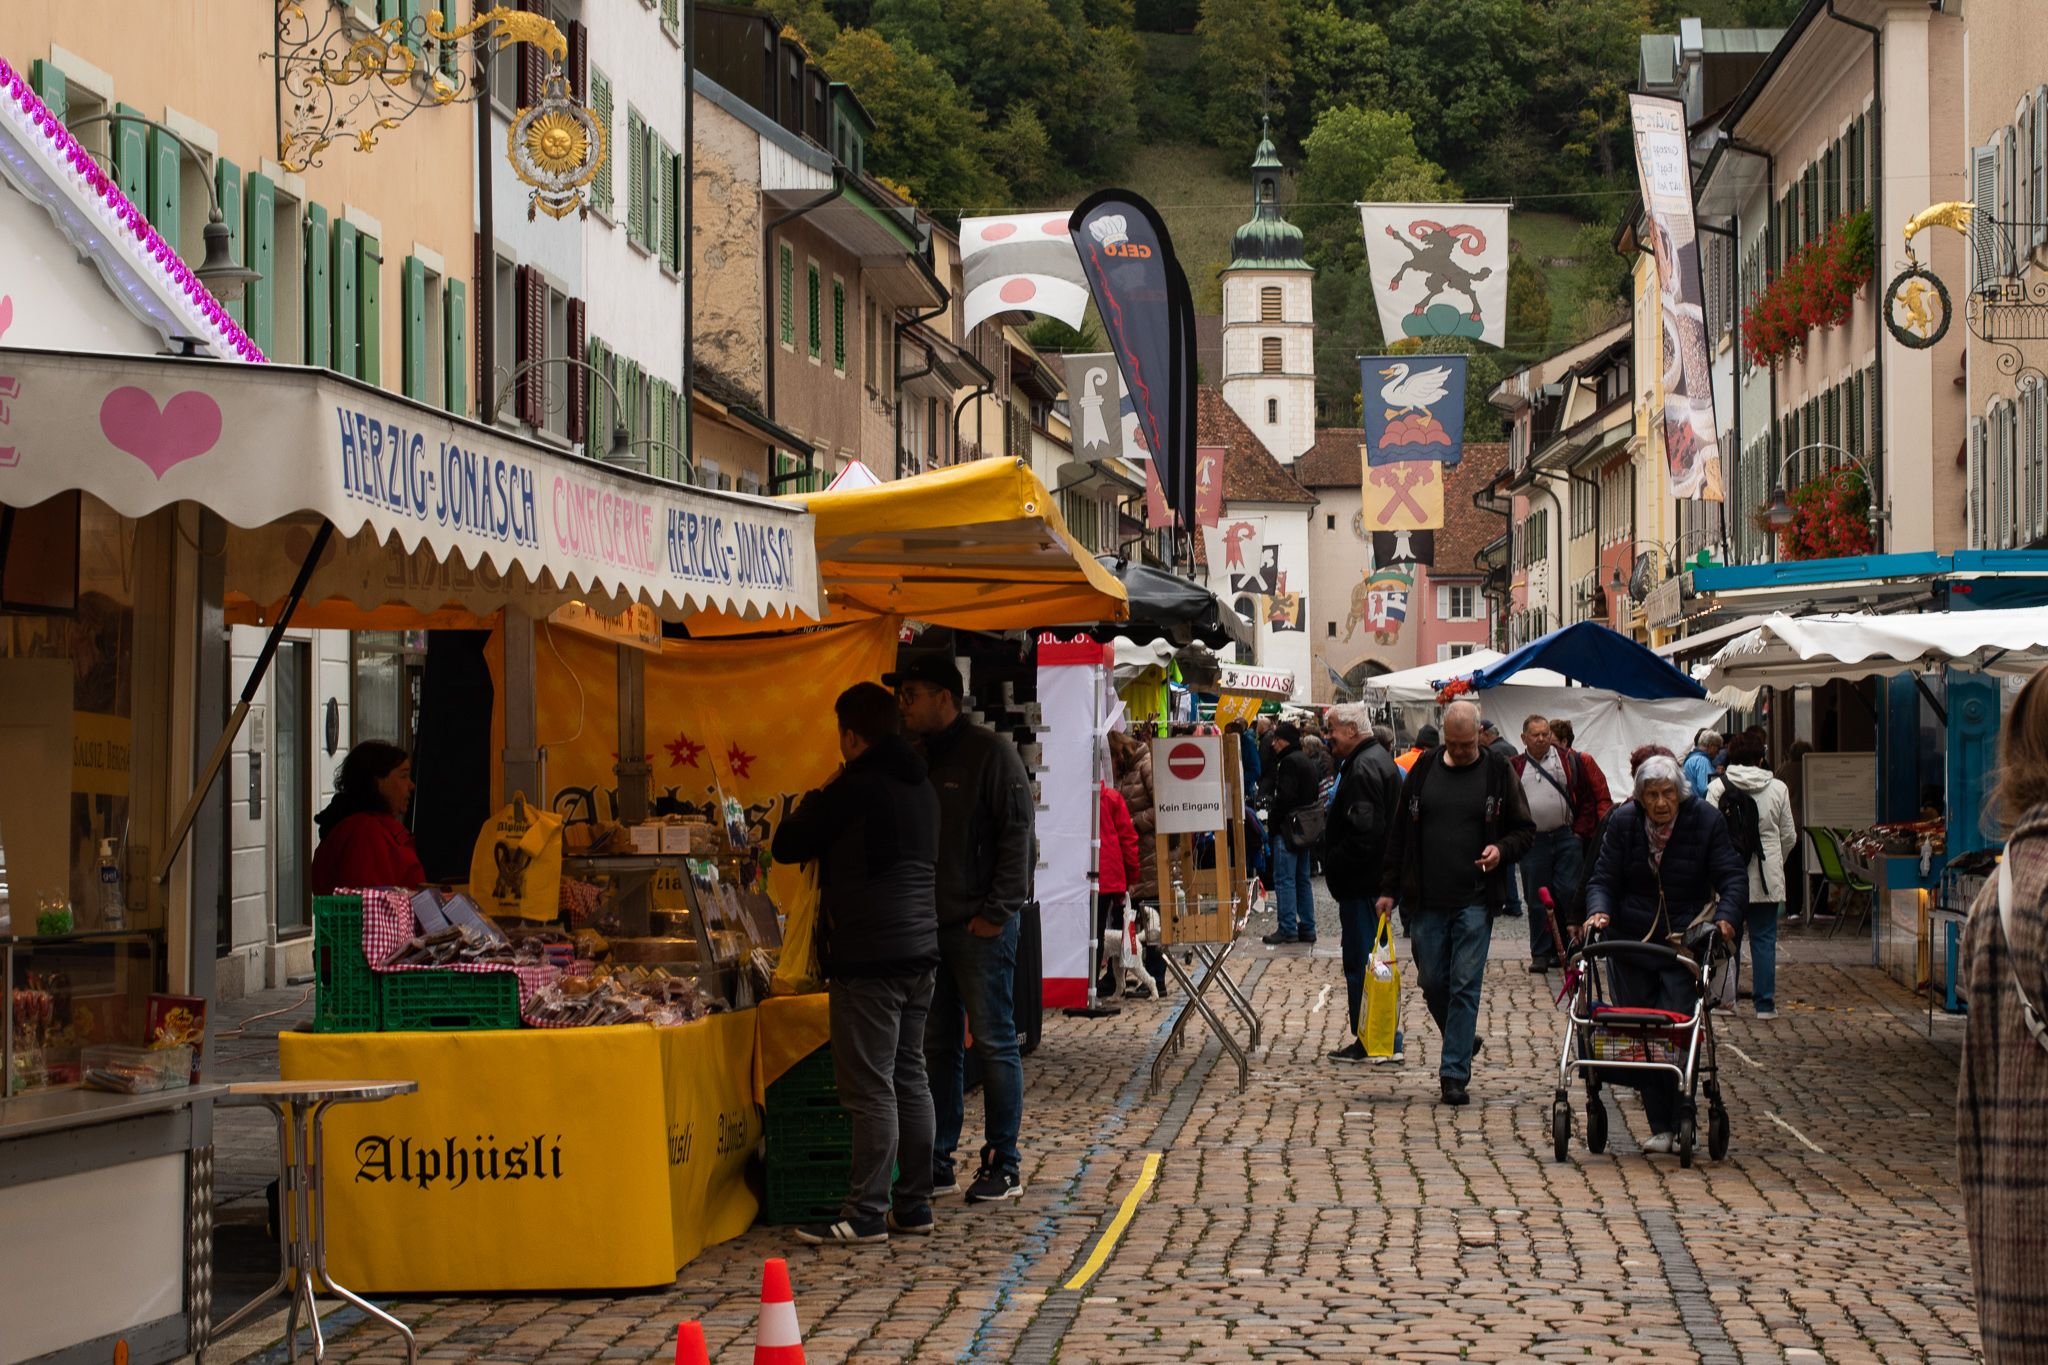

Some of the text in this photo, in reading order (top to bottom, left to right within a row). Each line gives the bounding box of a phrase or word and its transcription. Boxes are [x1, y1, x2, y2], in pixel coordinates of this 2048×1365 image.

[336, 407, 540, 551] HERZIG-JONASCH
[552, 476, 657, 578] CONFISERIE
[1159, 801, 1220, 813] Kein Eingang
[102, 870, 117, 882] gel
[354, 1134, 564, 1191] Alphüsli
